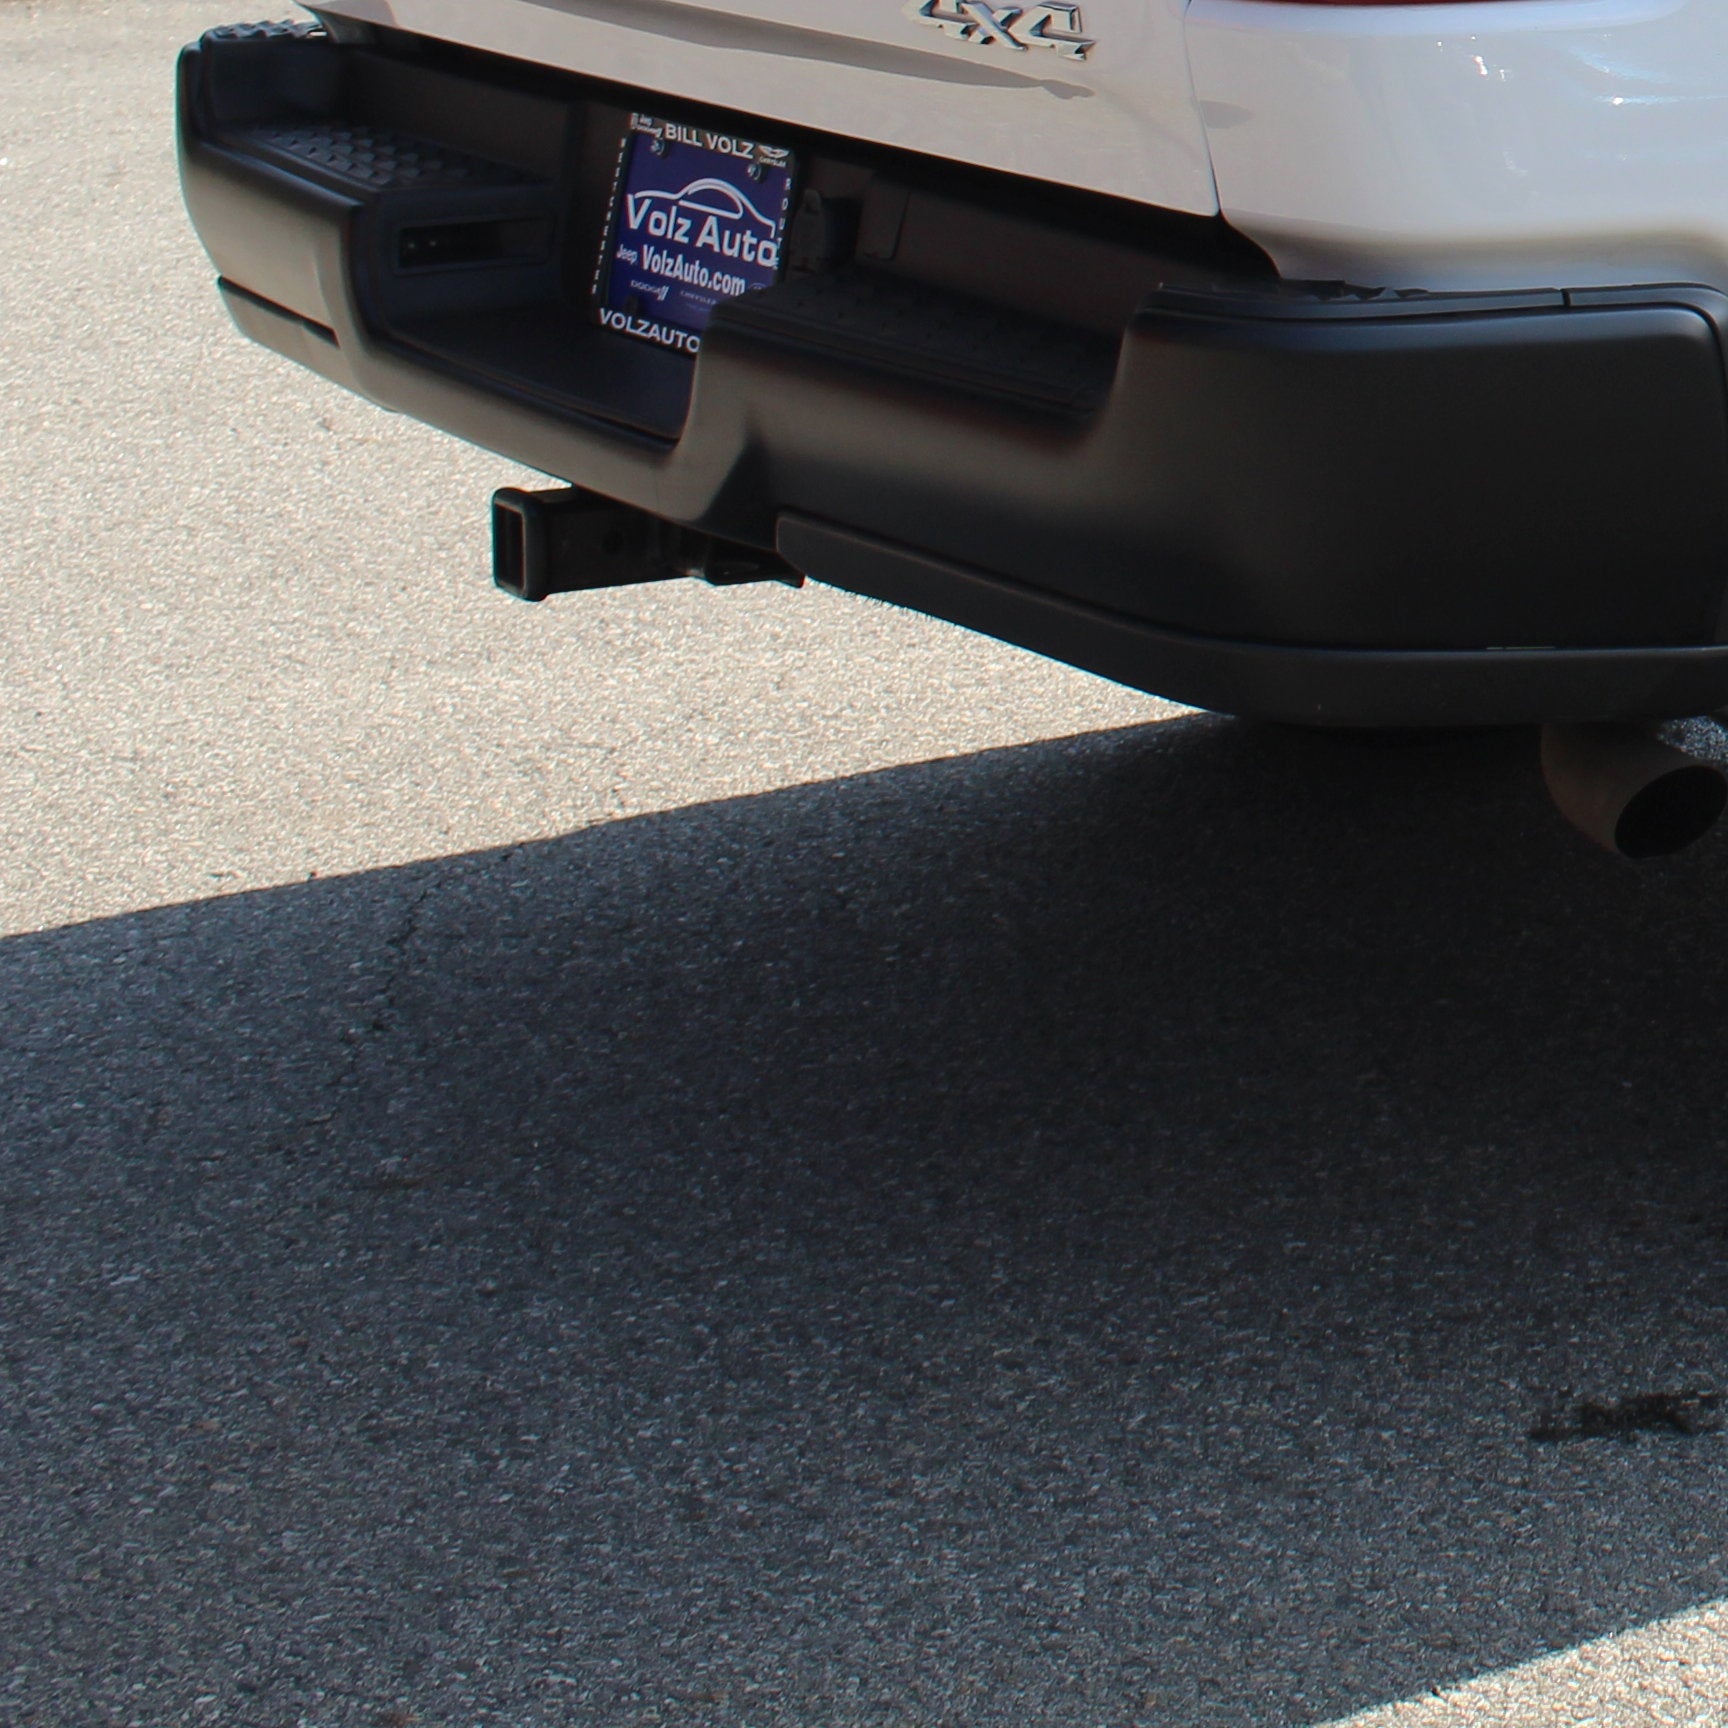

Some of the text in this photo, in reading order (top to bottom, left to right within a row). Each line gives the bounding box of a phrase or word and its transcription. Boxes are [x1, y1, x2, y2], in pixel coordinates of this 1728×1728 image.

[665, 123, 703, 147] BILL
[706, 132, 754, 159] VOLZ
[626, 193, 779, 268] Volz Auto
[616, 243, 638, 265] Jeep
[643, 244, 745, 296] VolzAuto.com
[600, 307, 700, 353] VOLZAUTO
